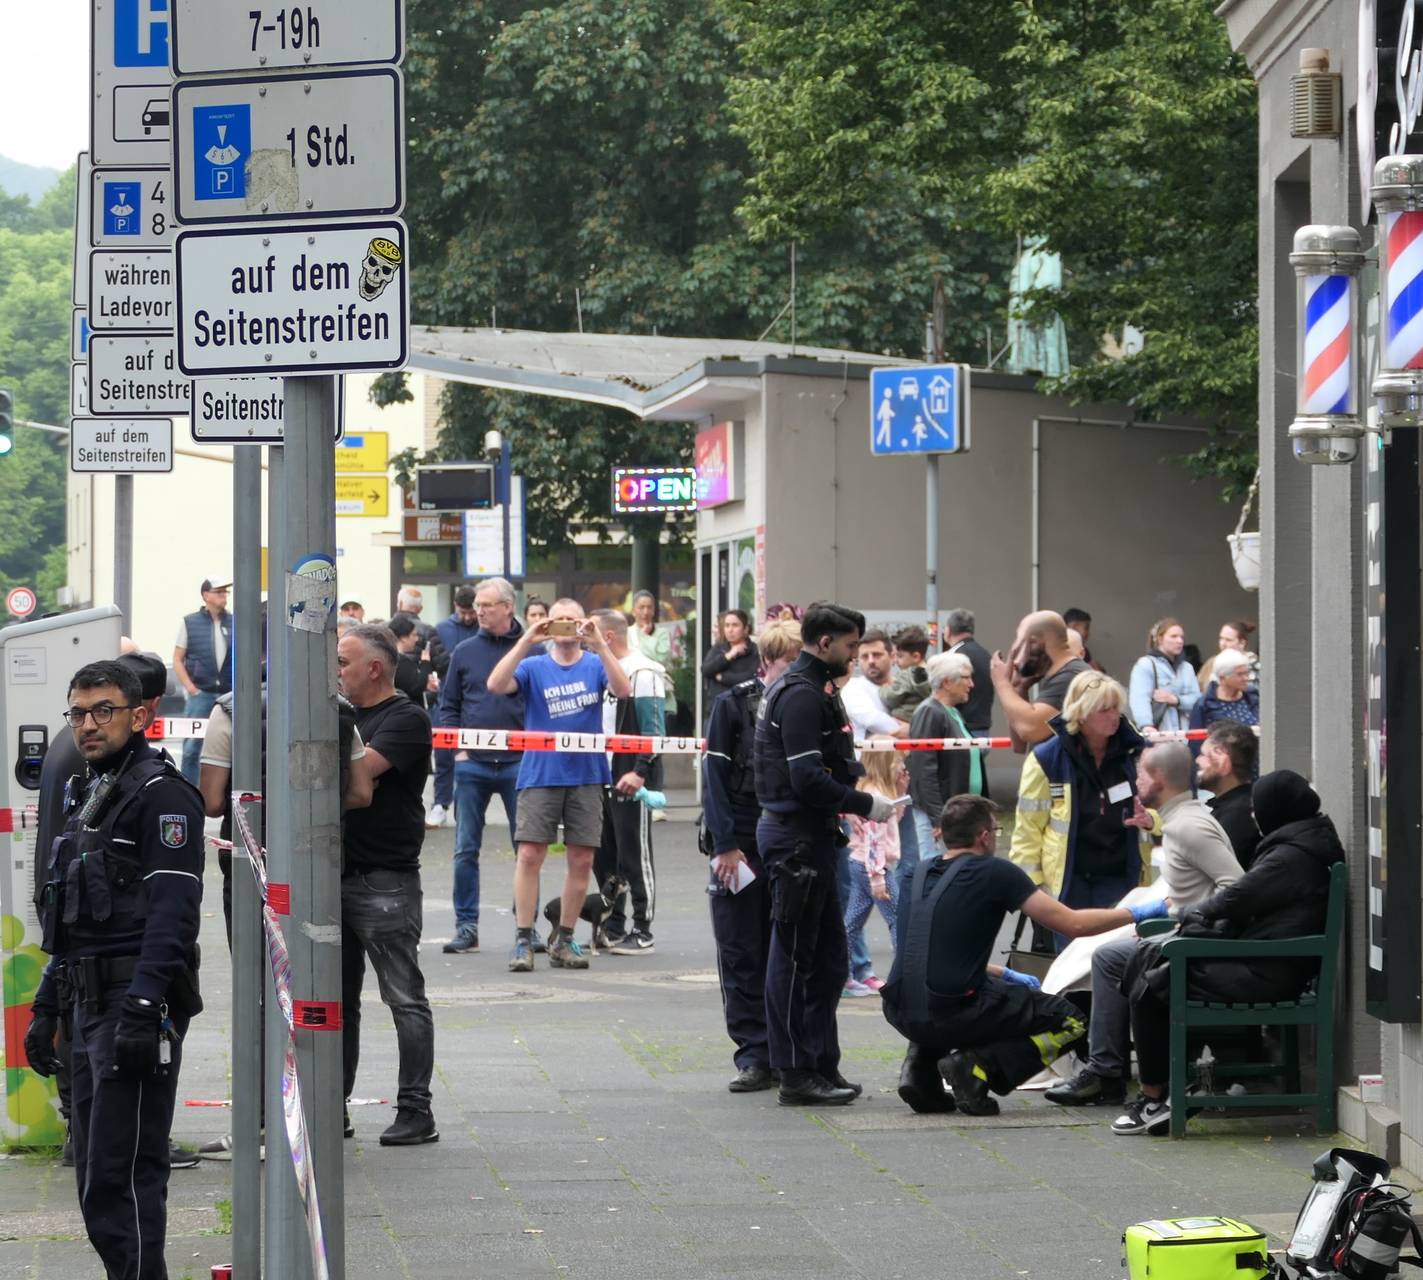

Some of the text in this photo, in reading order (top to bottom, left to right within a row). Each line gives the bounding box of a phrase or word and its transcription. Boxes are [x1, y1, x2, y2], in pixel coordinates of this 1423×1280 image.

[287, 124, 355, 168] 1 Std.
[377, 241, 399, 256] BVB
[104, 264, 170, 285] währen
[231, 254, 349, 294] auf dem
[100, 295, 172, 317] Ladevor
[194, 303, 389, 347] Seitenstreifen
[125, 350, 154, 371] auf
[95, 428, 149, 443] auf dem
[78, 448, 166, 462] Seitenstreifen
[619, 477, 691, 502] OPEN
[548, 699, 577, 714] MEINE
